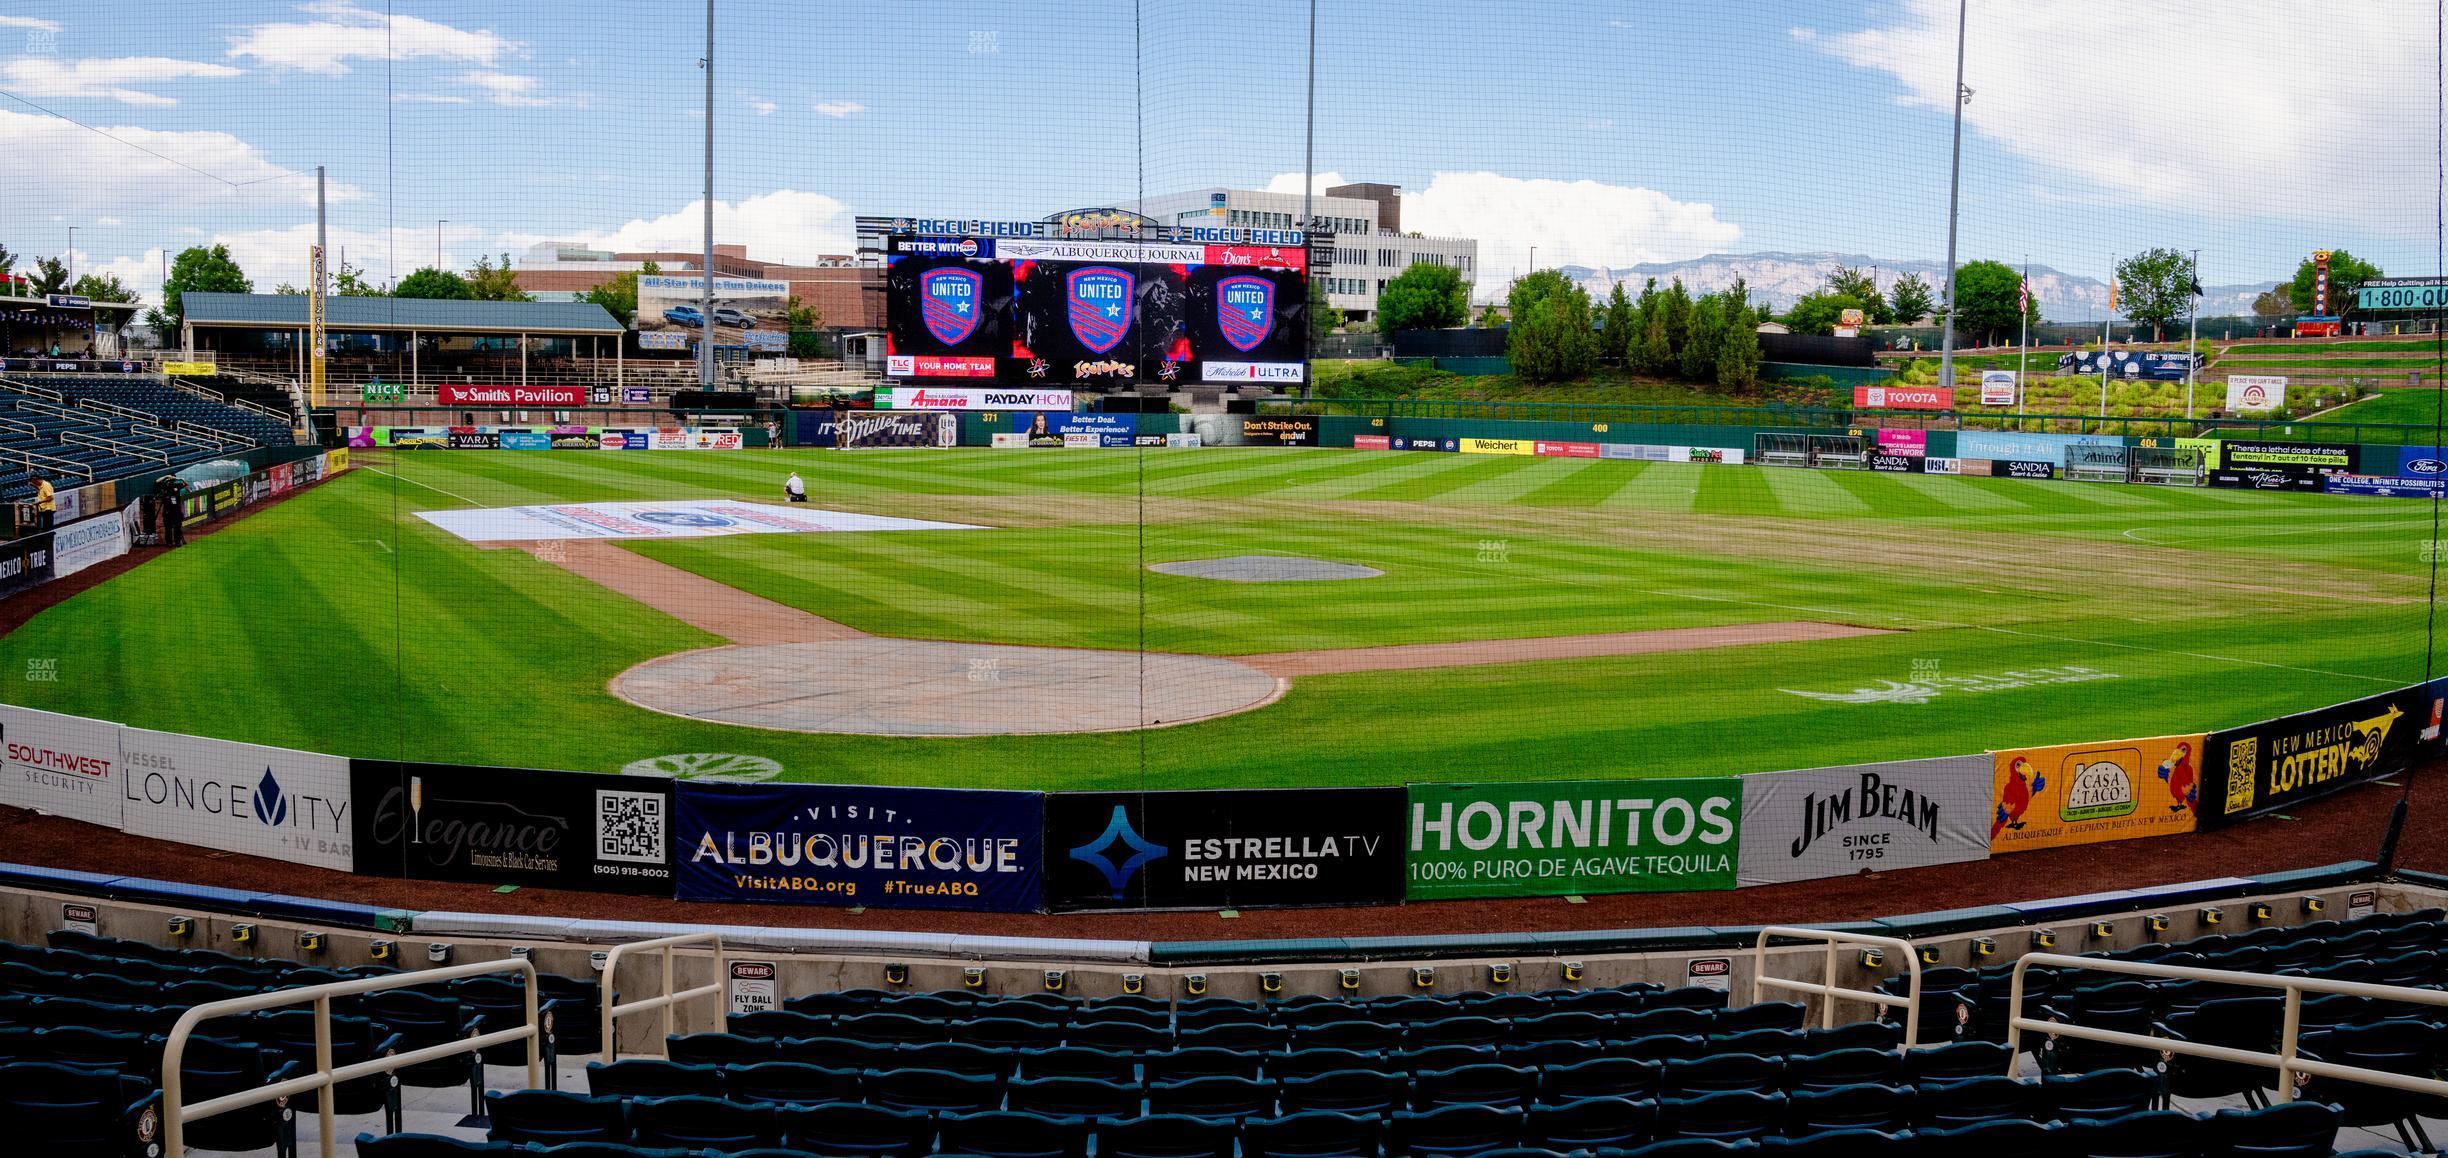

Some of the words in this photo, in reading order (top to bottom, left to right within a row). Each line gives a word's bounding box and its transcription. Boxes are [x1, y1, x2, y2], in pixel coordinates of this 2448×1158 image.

[918, 219, 970, 235] RGCU
[979, 220, 1033, 236] FIELD
[1193, 226, 1243, 242] RGCU
[1250, 229, 1303, 245] FIELD
[898, 242, 936, 252] BETTER
[938, 242, 963, 252] WITH
[1051, 246, 1146, 260] ALBUQUERQUE
[1147, 248, 1204, 261] JOURNAL
[1220, 247, 1251, 265] Dion's
[644, 277, 687, 288] All-Star
[690, 279, 721, 289] Hoe
[723, 281, 745, 290] Run
[745, 282, 786, 292] Drivers
[932, 282, 971, 297] UNITED
[2381, 280, 2397, 288] Help
[2397, 280, 2425, 288] Quitting
[1079, 283, 1122, 299] UNITED
[1227, 290, 1264, 304] UNITED
[56, 363, 77, 371] PEPSI
[891, 359, 909, 367] TLC
[918, 362, 941, 370] YOUR
[943, 362, 967, 370] HOME
[970, 362, 992, 371] TEAM
[1073, 360, 1135, 378] ISOTOPES
[1258, 367, 1299, 377] ULTRA
[367, 385, 401, 394] NICK
[470, 387, 511, 402] Smith's
[515, 388, 574, 402] Pavilion
[593, 393, 610, 403] 19
[911, 389, 968, 407] Amana
[984, 394, 1036, 405] PAYDAY
[1036, 394, 1070, 405] HCM
[1888, 393, 1938, 403] TOYOTA
[982, 413, 998, 423] 371
[1072, 416, 1094, 424] Better
[1095, 416, 1116, 424] Deal.
[892, 423, 923, 435] TIME
[1060, 425, 1084, 434] Better
[1243, 420, 1267, 430] Don't
[1267, 420, 1293, 430] Strike
[1294, 420, 1312, 430] Out.
[1592, 424, 1609, 433] 400
[460, 435, 489, 444] VARA
[719, 435, 738, 445] RED
[1065, 435, 1088, 443] FIESTA
[1413, 440, 1436, 448] PEPSI
[1475, 439, 1519, 450] Weichert
[2140, 439, 2157, 448] 404
[1888, 449, 1926, 457] NETWORK
[1968, 440, 2018, 455] Through
[2268, 445, 2291, 453] lethal
[2291, 446, 2311, 454] dose
[2322, 448, 2346, 456] street
[1872, 455, 1909, 466] SANDIA
[2232, 453, 2263, 462] fentanyl
[1926, 458, 1949, 472] USL
[2008, 461, 2050, 472] SANDIA
[2413, 460, 2439, 472] Ford
[2342, 477, 2371, 485] COLLEGE,
[2372, 478, 2399, 486] INFINITE
[29, 549, 46, 569] TRUE
[2273, 733, 2300, 756] NEW
[2305, 721, 2353, 748] MEXICO
[8, 744, 111, 778] SOUTHWEST
[123, 751, 176, 770] VESSEL
[2269, 741, 2351, 795] LOTTERY
[25, 770, 94, 795] SECURITY
[2082, 772, 2120, 789] CASA
[126, 765, 347, 833] LONGEVITY
[2081, 786, 2120, 804] TACO
[807, 805, 897, 823] VISIT
[1791, 787, 1854, 858] JIM
[1857, 772, 1940, 845] BEAM
[1411, 796, 1734, 851] HORNITOS
[2002, 827, 2064, 841] ALBUQUERQUE
[2070, 822, 2110, 834] ELEPHANT
[2112, 819, 2136, 831] BUTTE
[2137, 816, 2156, 826] NEW
[2158, 813, 2188, 824] MEXICO
[1842, 833, 1891, 847] SINCE
[295, 837, 311, 851] IV
[318, 839, 351, 857] BAR
[1184, 836, 1340, 860] ESTRELLA
[1343, 835, 1380, 857] TV
[471, 850, 501, 867] Limousines
[502, 853, 508, 866] &
[508, 852, 524, 868] Black
[525, 854, 535, 868] Car
[535, 854, 557, 871] Services
[1849, 847, 1884, 861] 1795
[593, 864, 619, 876] (505)
[621, 866, 669, 878] 918-8002
[1184, 865, 1231, 882] NEW
[1236, 863, 1319, 881] MEXICO
[1410, 861, 1467, 880] 100%
[1473, 859, 1533, 879] PURO
[1538, 858, 1566, 878] DE
[1571, 856, 1641, 877] AGAVE
[1644, 854, 1730, 874] TEQUILA
[735, 875, 857, 895] VisitABQ.org
[884, 881, 979, 896] #TrueABQ
[2352, 894, 2371, 904] BEWARE
[69, 910, 92, 919] BEWARE
[737, 966, 769, 976] BEWARE
[1695, 963, 1724, 972] BEWARE
[735, 994, 750, 1003] FLY
[752, 995, 773, 1004] BALL
[743, 1004, 765, 1013] ZONE
